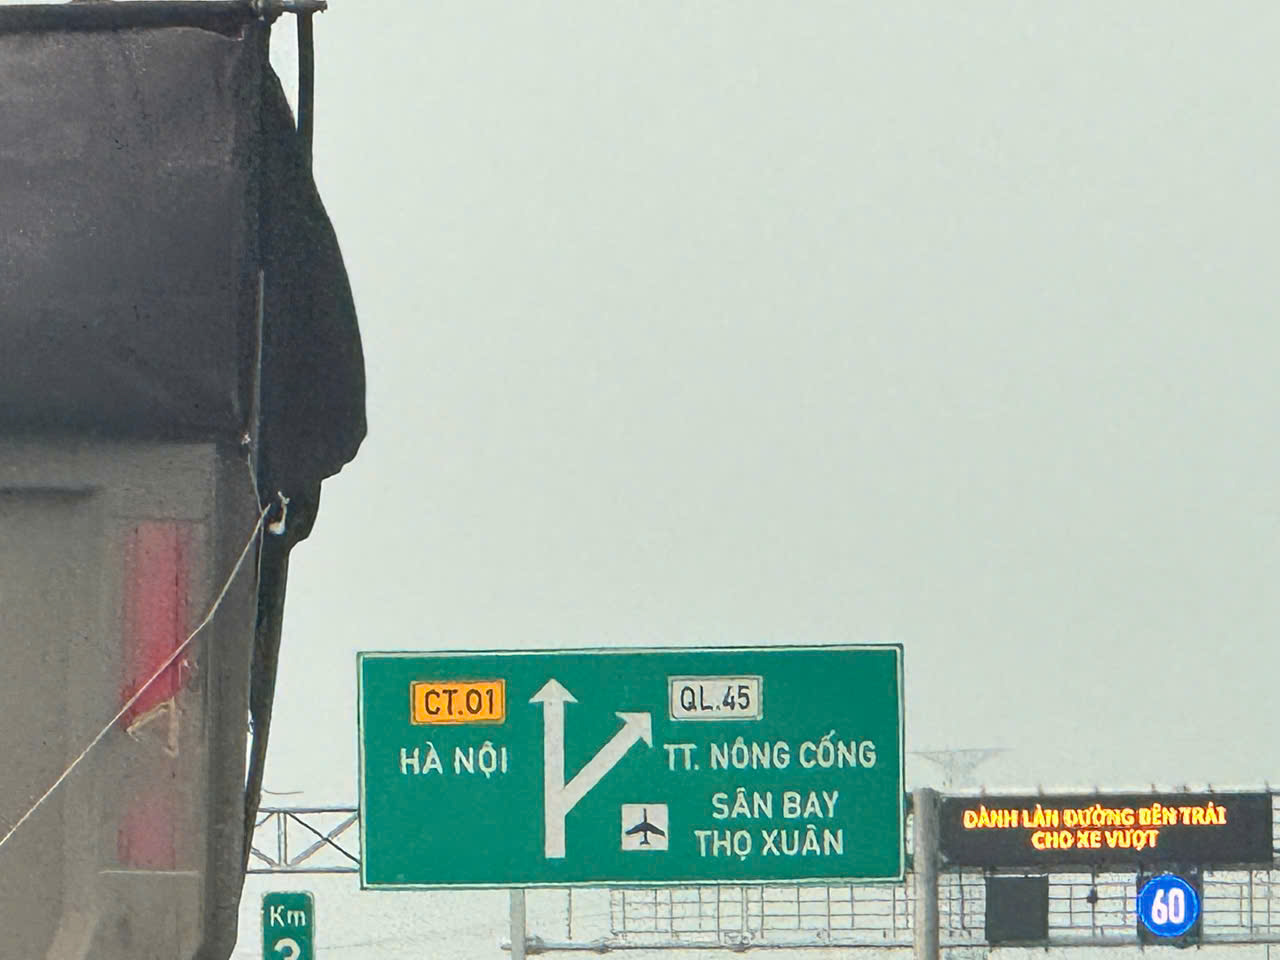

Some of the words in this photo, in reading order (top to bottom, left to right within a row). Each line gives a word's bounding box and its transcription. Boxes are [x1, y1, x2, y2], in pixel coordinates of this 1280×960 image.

[423, 688, 496, 716] CT.01
[679, 685, 752, 713] QL.45
[400, 741, 443, 775] HÀ
[454, 741, 509, 779] NỘI
[663, 743, 700, 771] TT.
[710, 737, 790, 770] NÔNG
[799, 730, 877, 770] CỐNG
[711, 786, 771, 819] SÂN
[782, 790, 839, 819] BAY
[694, 829, 752, 861] THỌ
[761, 824, 844, 857] XUÂN
[1031, 830, 1074, 850] CHO
[1077, 830, 1102, 849] XE
[1105, 829, 1159, 851] VƯỢT
[269, 905, 306, 928] Km
[1151, 887, 1185, 925] 60
